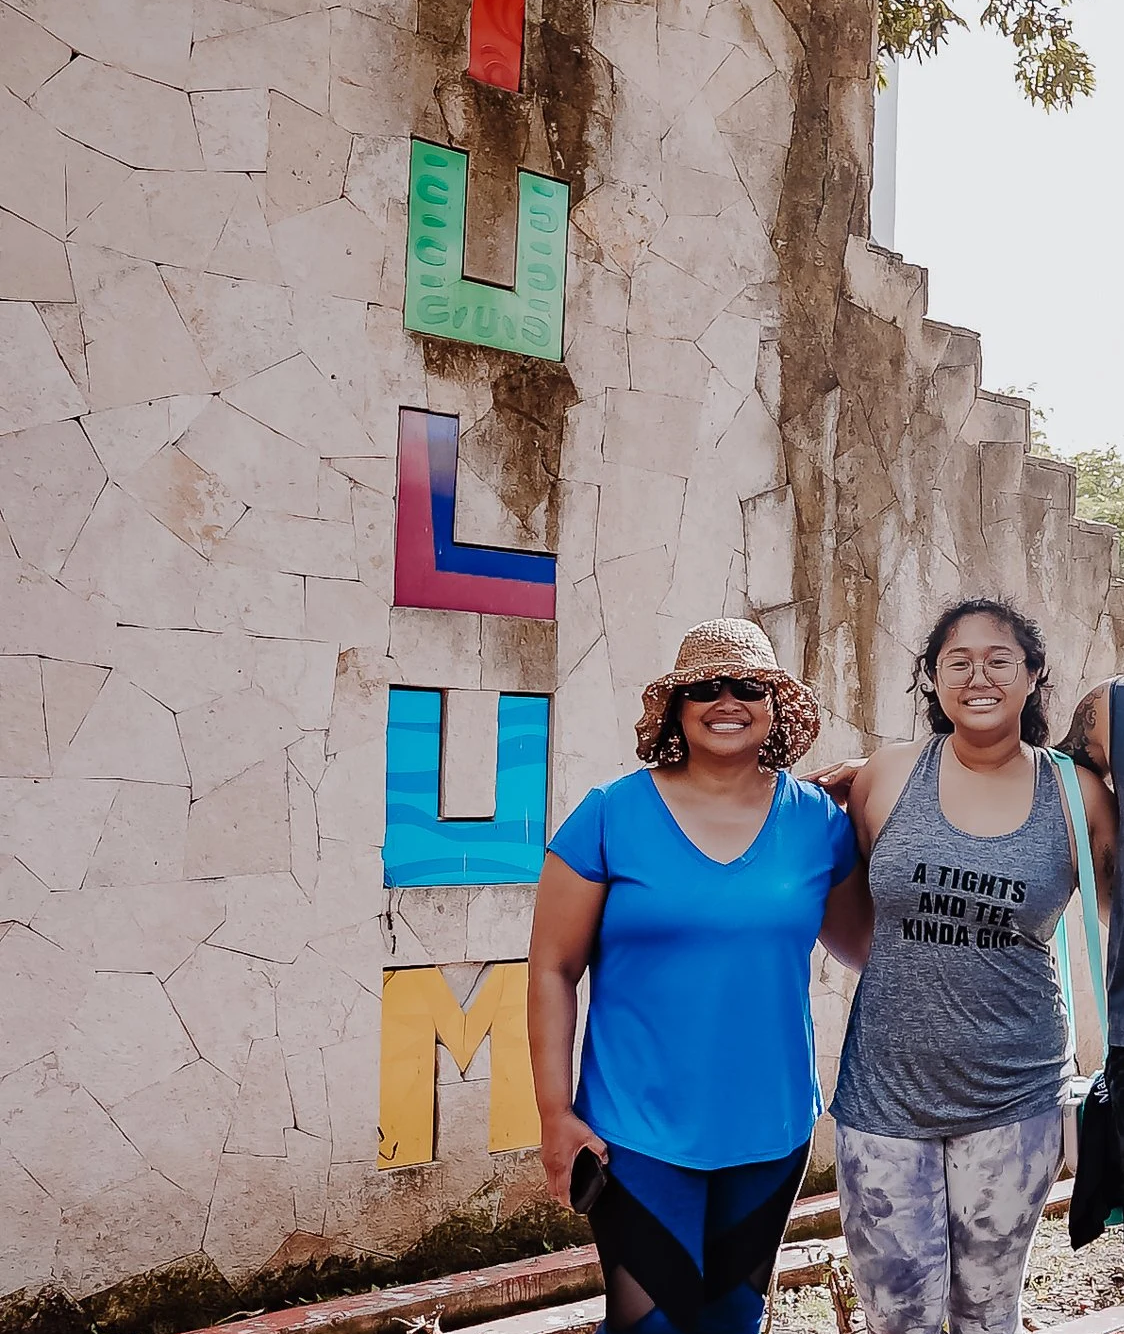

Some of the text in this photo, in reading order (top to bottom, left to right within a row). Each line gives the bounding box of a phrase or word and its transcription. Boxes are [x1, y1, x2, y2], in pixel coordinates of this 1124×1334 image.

[911, 862, 1027, 903] A TIGHTS
[919, 892, 1015, 926] AND TEE
[902, 918, 969, 947] KINDA
